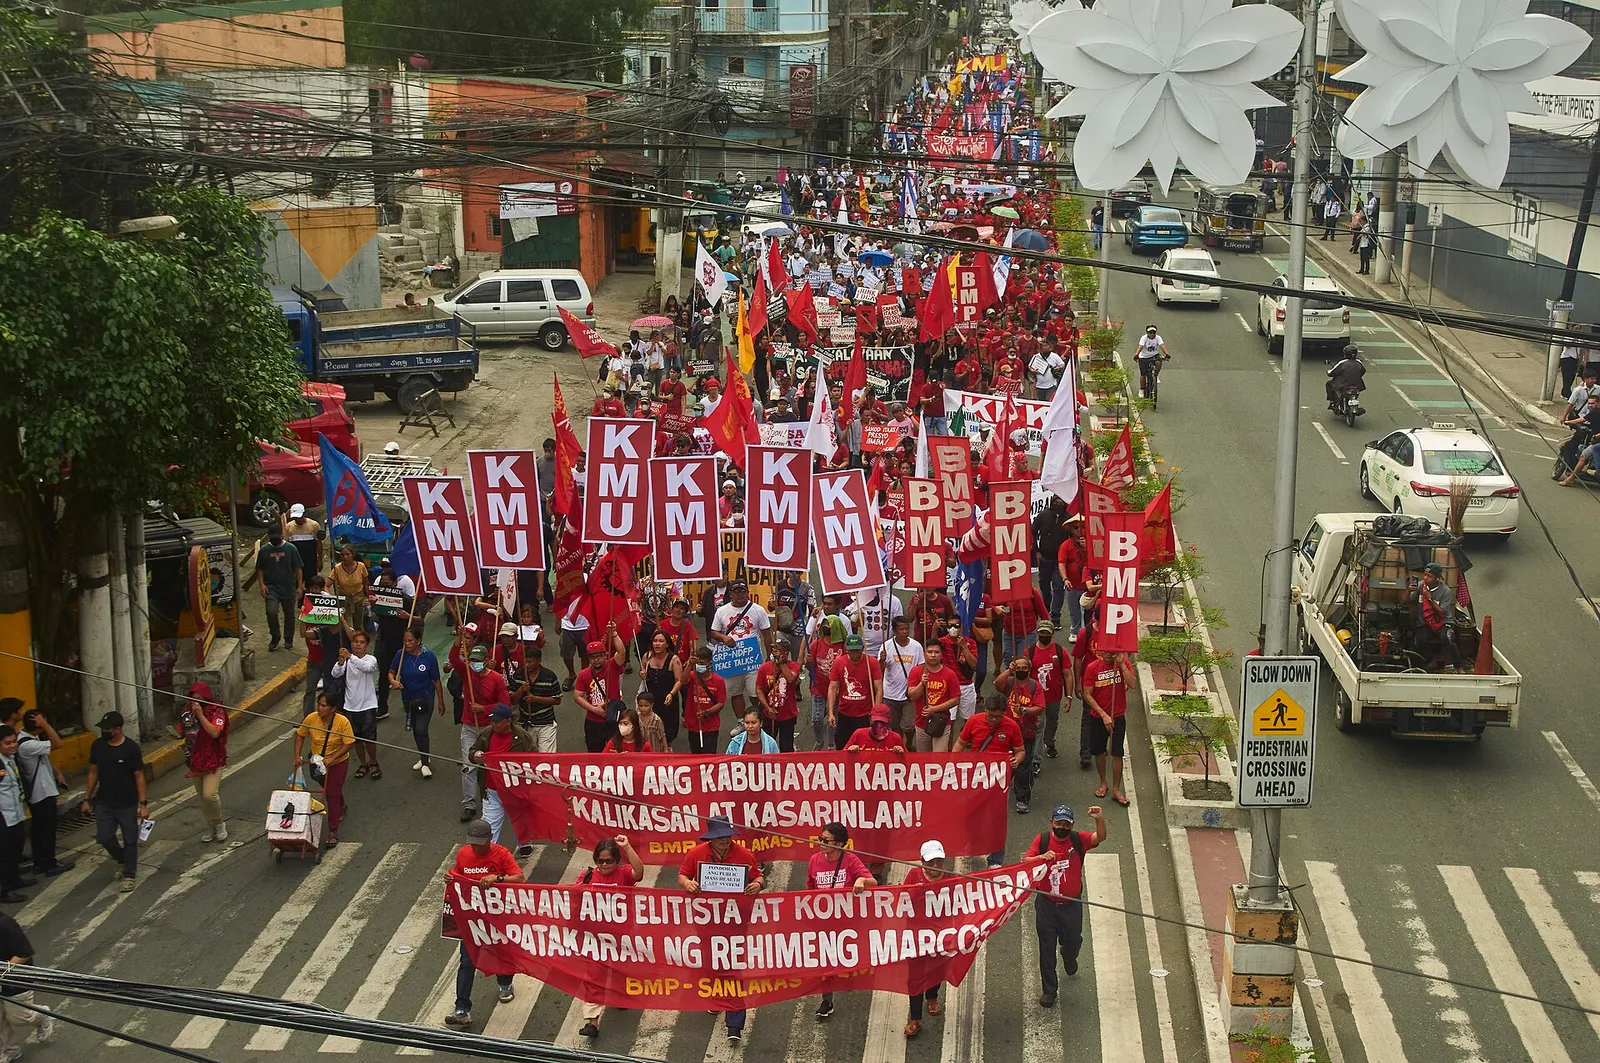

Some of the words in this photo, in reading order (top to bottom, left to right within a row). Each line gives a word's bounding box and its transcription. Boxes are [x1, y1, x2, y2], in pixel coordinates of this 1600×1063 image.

[957, 54, 1007, 72] KMU
[1554, 96, 1595, 120] PHILIPPINES
[931, 144, 955, 154] WAR
[932, 135, 957, 144] STOP
[1224, 240, 1251, 249] Likers
[960, 271, 979, 321] BMP
[866, 438, 889, 446] IBABA!
[599, 424, 641, 536] KMU
[936, 445, 972, 528] BMP
[485, 455, 529, 562] KMU
[665, 463, 706, 574] KMU
[760, 452, 798, 563] KMU
[417, 482, 466, 588] KMU
[818, 475, 868, 585] KMU
[908, 480, 942, 583] BMP
[995, 490, 1026, 590] BMP
[1105, 530, 1138, 635] BMP
[314, 598, 337, 606] FOOD
[314, 613, 334, 621] WAR
[712, 647, 754, 662] GRP-NDFP
[715, 662, 732, 671] PEACE
[734, 654, 759, 667] TALKS!
[1251, 665, 1279, 683] SLOW
[1282, 665, 1311, 683] DOWN
[1247, 740, 1308, 757] PEDESTRIAN
[499, 761, 635, 796] IPAGLABAN
[642, 765, 692, 795] ANG
[699, 761, 846, 793] KABUHAYAN
[1247, 761, 1306, 777] CROSSING
[1255, 781, 1295, 797] AHEAD
[572, 796, 701, 833] KALIKASAN
[743, 800, 923, 829] KASARINLAN!
[454, 881, 571, 920] LABANAN
[580, 891, 627, 924] ANG
[635, 894, 742, 925] ELITISTA
[750, 898, 784, 924] AT
[795, 890, 915, 920] KONTRA
[925, 863, 1047, 918] MAHIRAP
[664, 936, 703, 968] NG
[711, 929, 858, 970] REHIMENG
[869, 918, 994, 966] MARCOS
[626, 977, 679, 996] BMP
